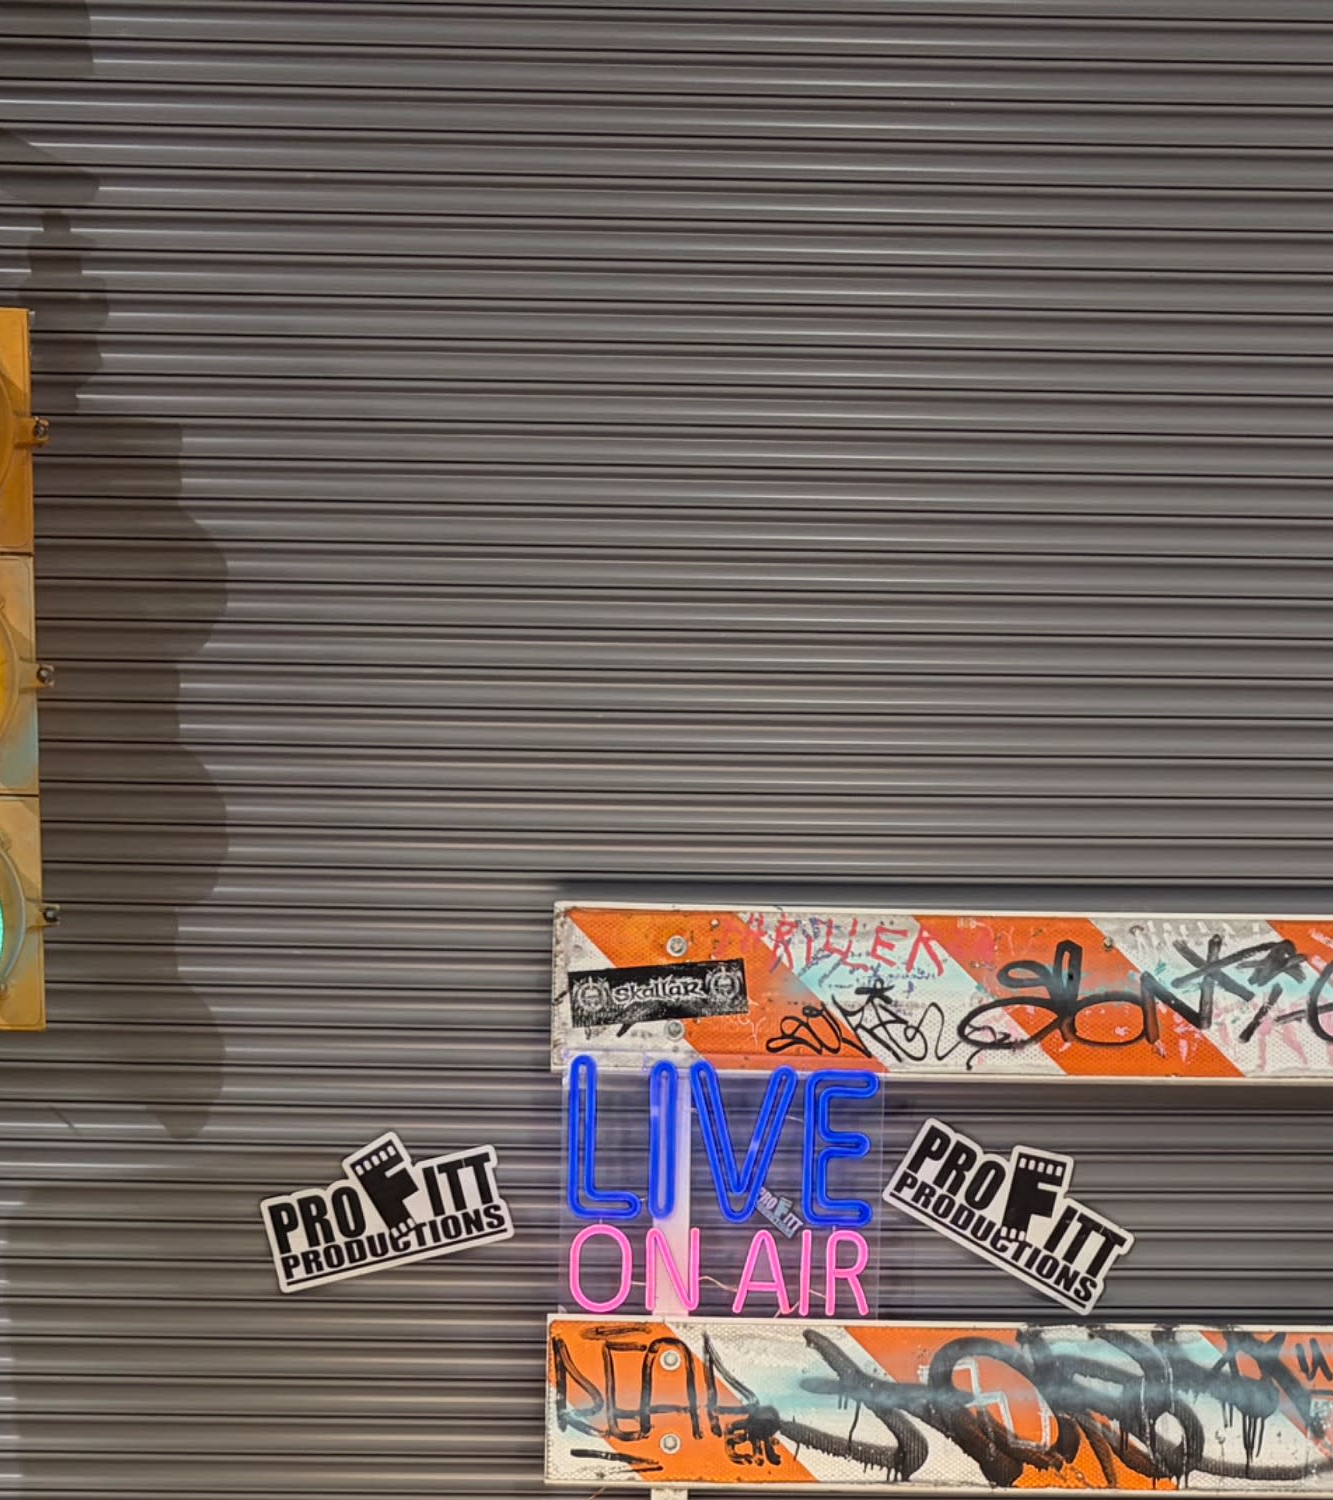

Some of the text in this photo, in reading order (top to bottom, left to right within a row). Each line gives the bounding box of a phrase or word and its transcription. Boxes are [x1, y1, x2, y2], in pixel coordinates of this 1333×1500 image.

[267, 1139, 492, 1255] PROFITT
[567, 1054, 880, 1227] LIVE
[906, 1123, 1128, 1280] PROFITT
[280, 1203, 507, 1281] PRODUCTIONS
[568, 1223, 870, 1317] ON AIR
[892, 1170, 1099, 1303] PRODUCTIONS
